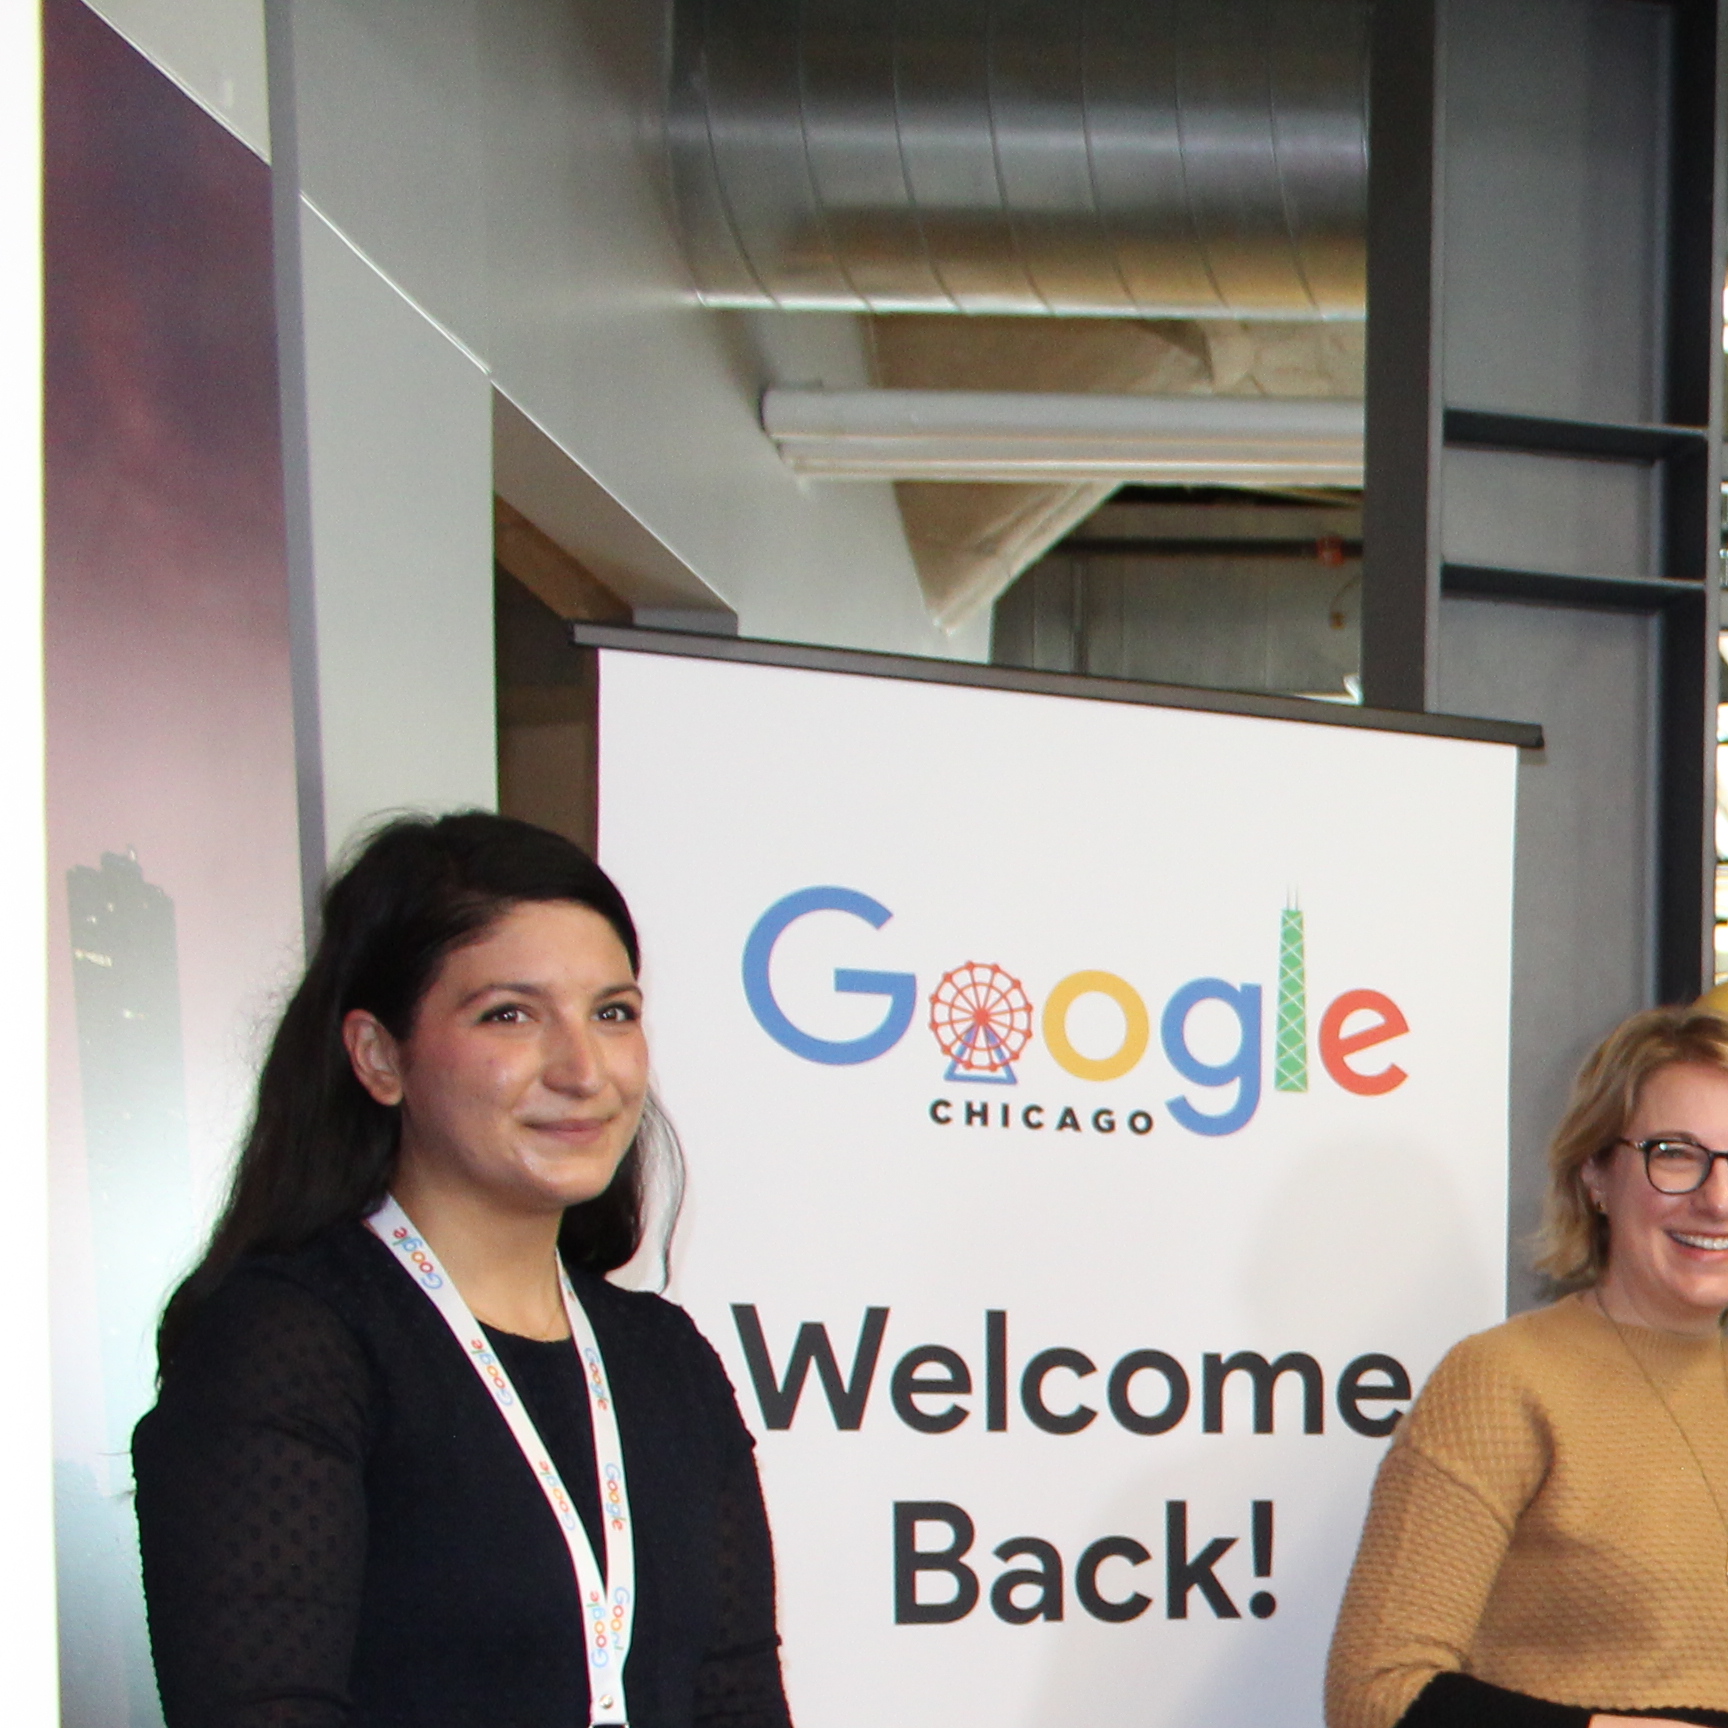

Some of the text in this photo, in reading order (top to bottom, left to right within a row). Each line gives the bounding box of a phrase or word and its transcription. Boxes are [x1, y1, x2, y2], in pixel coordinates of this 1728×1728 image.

[741, 884, 1411, 1137] Google
[930, 1100, 1154, 1134] CHICAGO
[392, 1227, 443, 1289] Google
[471, 1339, 513, 1406] Google
[585, 1348, 609, 1411] Google
[730, 1303, 1412, 1437] Welcome
[539, 1460, 575, 1531] Google
[605, 1463, 626, 1530] Google
[892, 1500, 1278, 1625] Back!
[586, 1590, 609, 1668] Google
